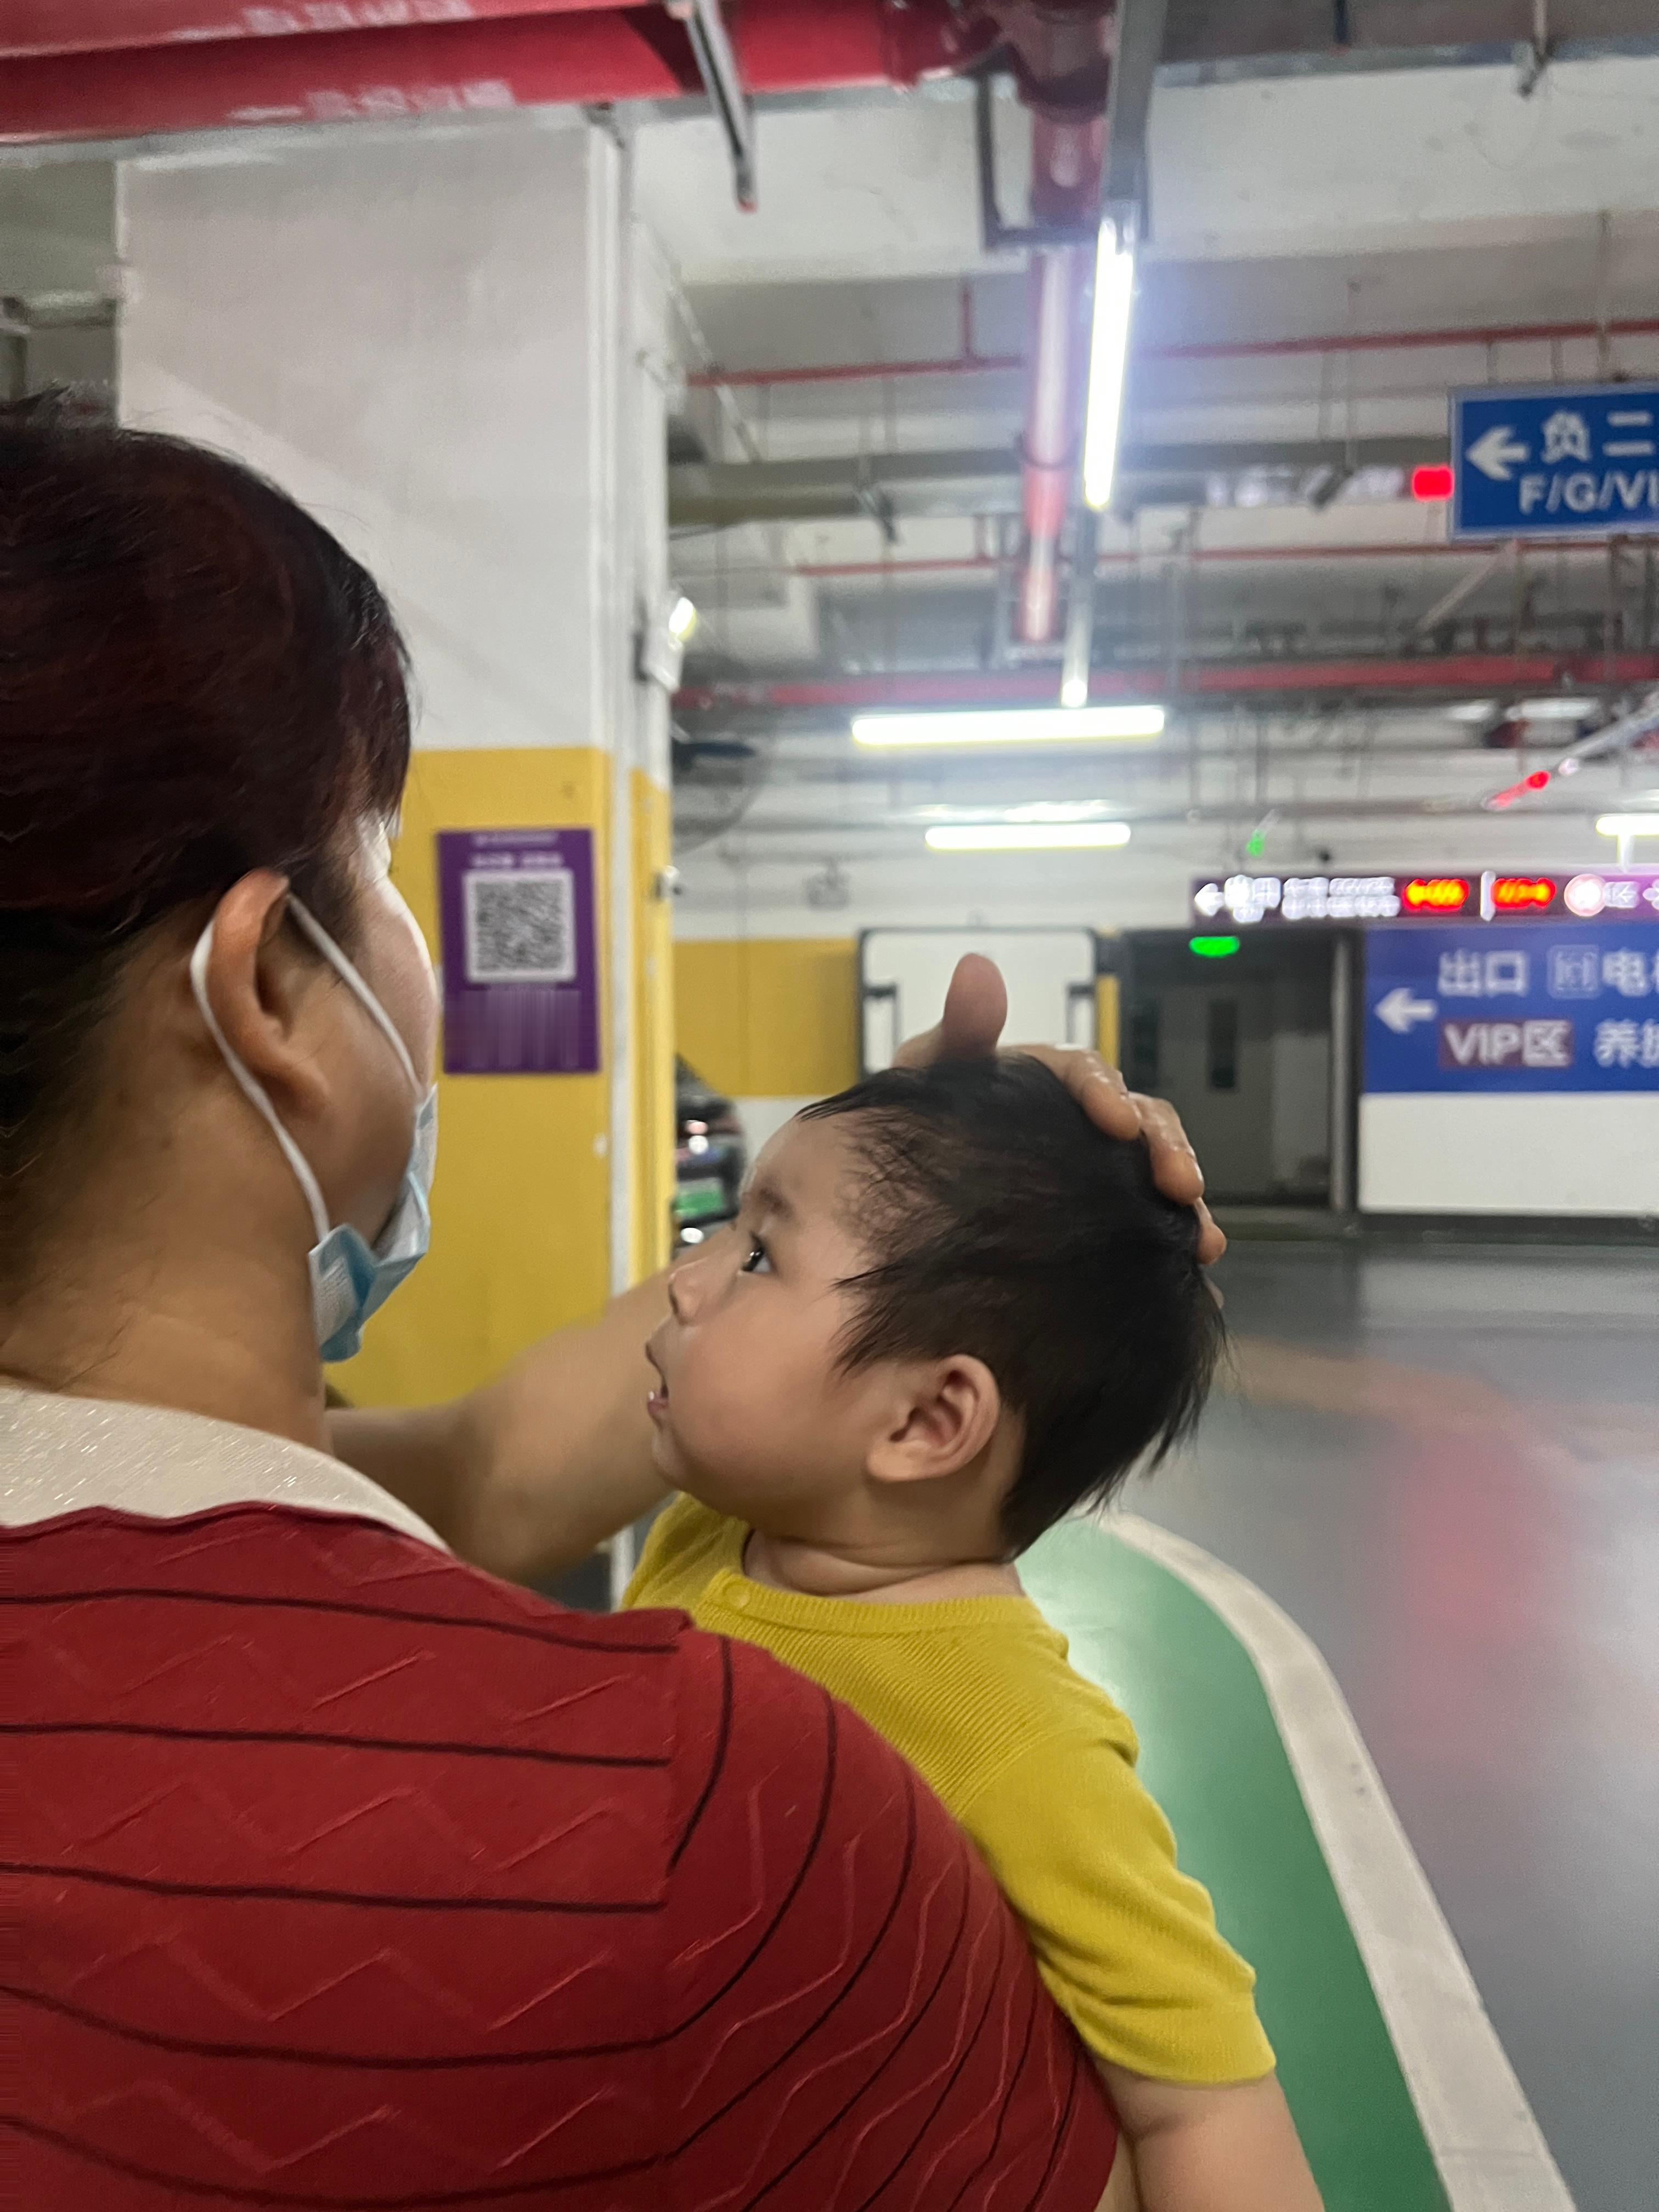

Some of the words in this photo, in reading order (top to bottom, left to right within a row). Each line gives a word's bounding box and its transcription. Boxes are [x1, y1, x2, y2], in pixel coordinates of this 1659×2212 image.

[1437, 949, 1528, 997] 出口
[1601, 947, 1659, 997] 电
[1444, 1019, 1571, 1068] VIP区
